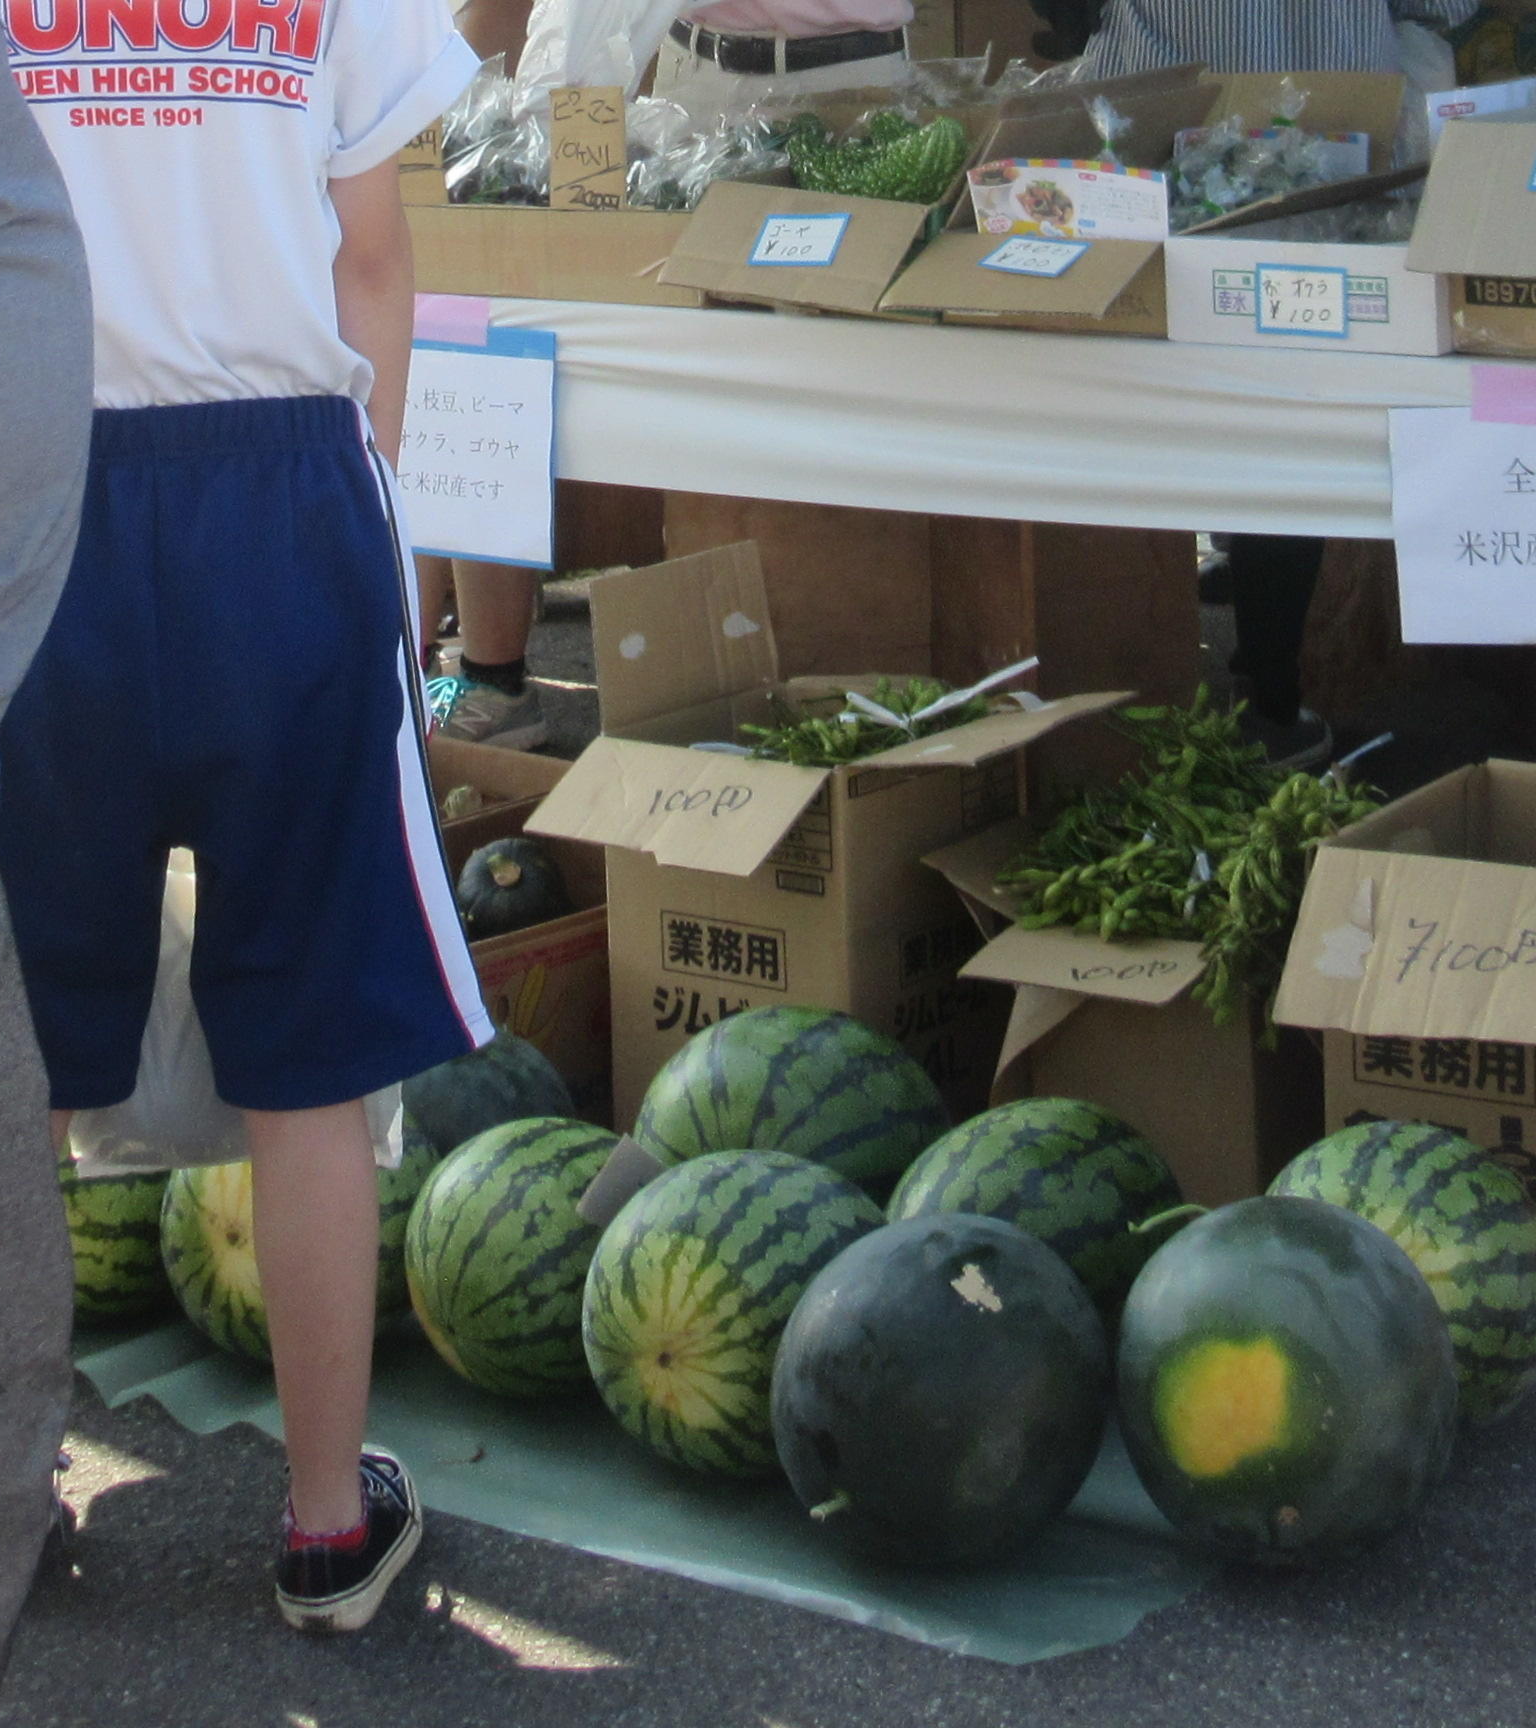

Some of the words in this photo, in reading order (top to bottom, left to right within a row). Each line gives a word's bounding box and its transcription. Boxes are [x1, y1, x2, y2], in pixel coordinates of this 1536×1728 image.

[14, 69, 79, 96] UEN
[93, 67, 175, 95] HIGH
[187, 67, 309, 104] SCHOOL
[69, 107, 146, 127] SINCE
[152, 107, 204, 126] 1901
[667, 918, 781, 983] 業務用
[652, 984, 750, 1036] ジムビ
[1363, 1035, 1526, 1095] 業務用
